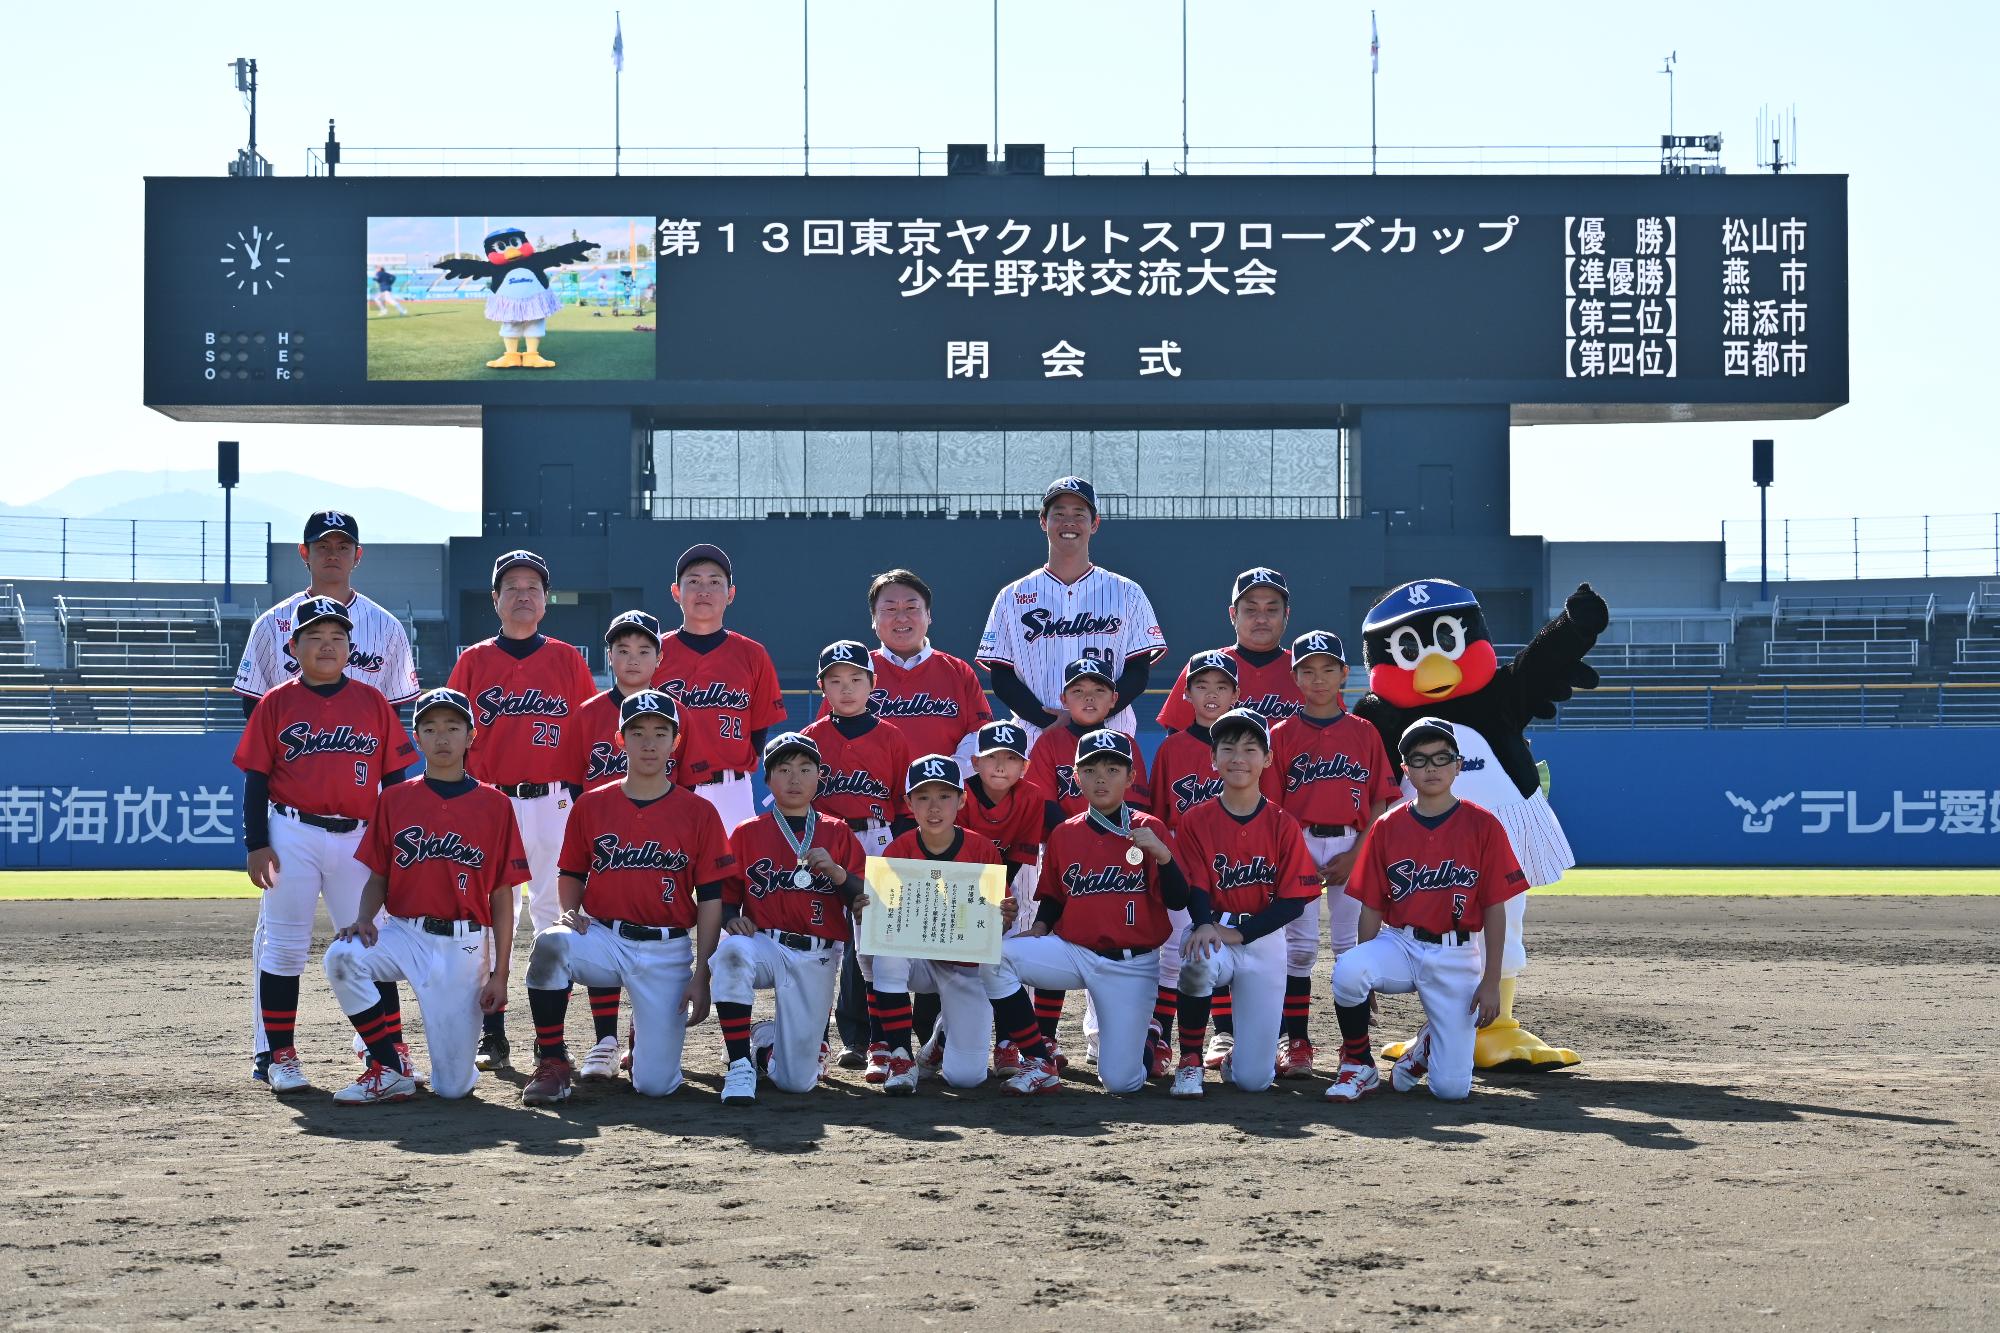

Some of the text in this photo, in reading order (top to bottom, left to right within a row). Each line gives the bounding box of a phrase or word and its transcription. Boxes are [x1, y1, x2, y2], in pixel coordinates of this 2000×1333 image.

[1722, 216, 1807, 255] 松山市
[898, 259, 1278, 298] 少年野球交流大会
[1565, 257, 1676, 296] 【準優勝】
[1566, 298, 1808, 337] 【第三位】 浦添市
[205, 332, 215, 344] B
[205, 350, 215, 362] S
[278, 332, 288, 344] H
[279, 350, 288, 362] E
[204, 368, 215, 380] O
[276, 368, 290, 380] Fc
[1566, 338, 1808, 378] 【第四位】 西都市
[1021, 608, 1122, 643] Swallows
[476, 686, 569, 726] Swallows
[278, 722, 378, 761] Swallows
[533, 721, 561, 748] 29
[354, 761, 368, 786] 9
[1286, 752, 1370, 792] Swallows
[1801, 790, 2000, 834] テレビ愛
[394, 825, 485, 869] Swallows
[592, 833, 689, 875] Swallows
[662, 877, 676, 903] 2
[1387, 858, 1479, 902] Swallows
[810, 900, 824, 925] 3
[1125, 901, 1135, 926] 1
